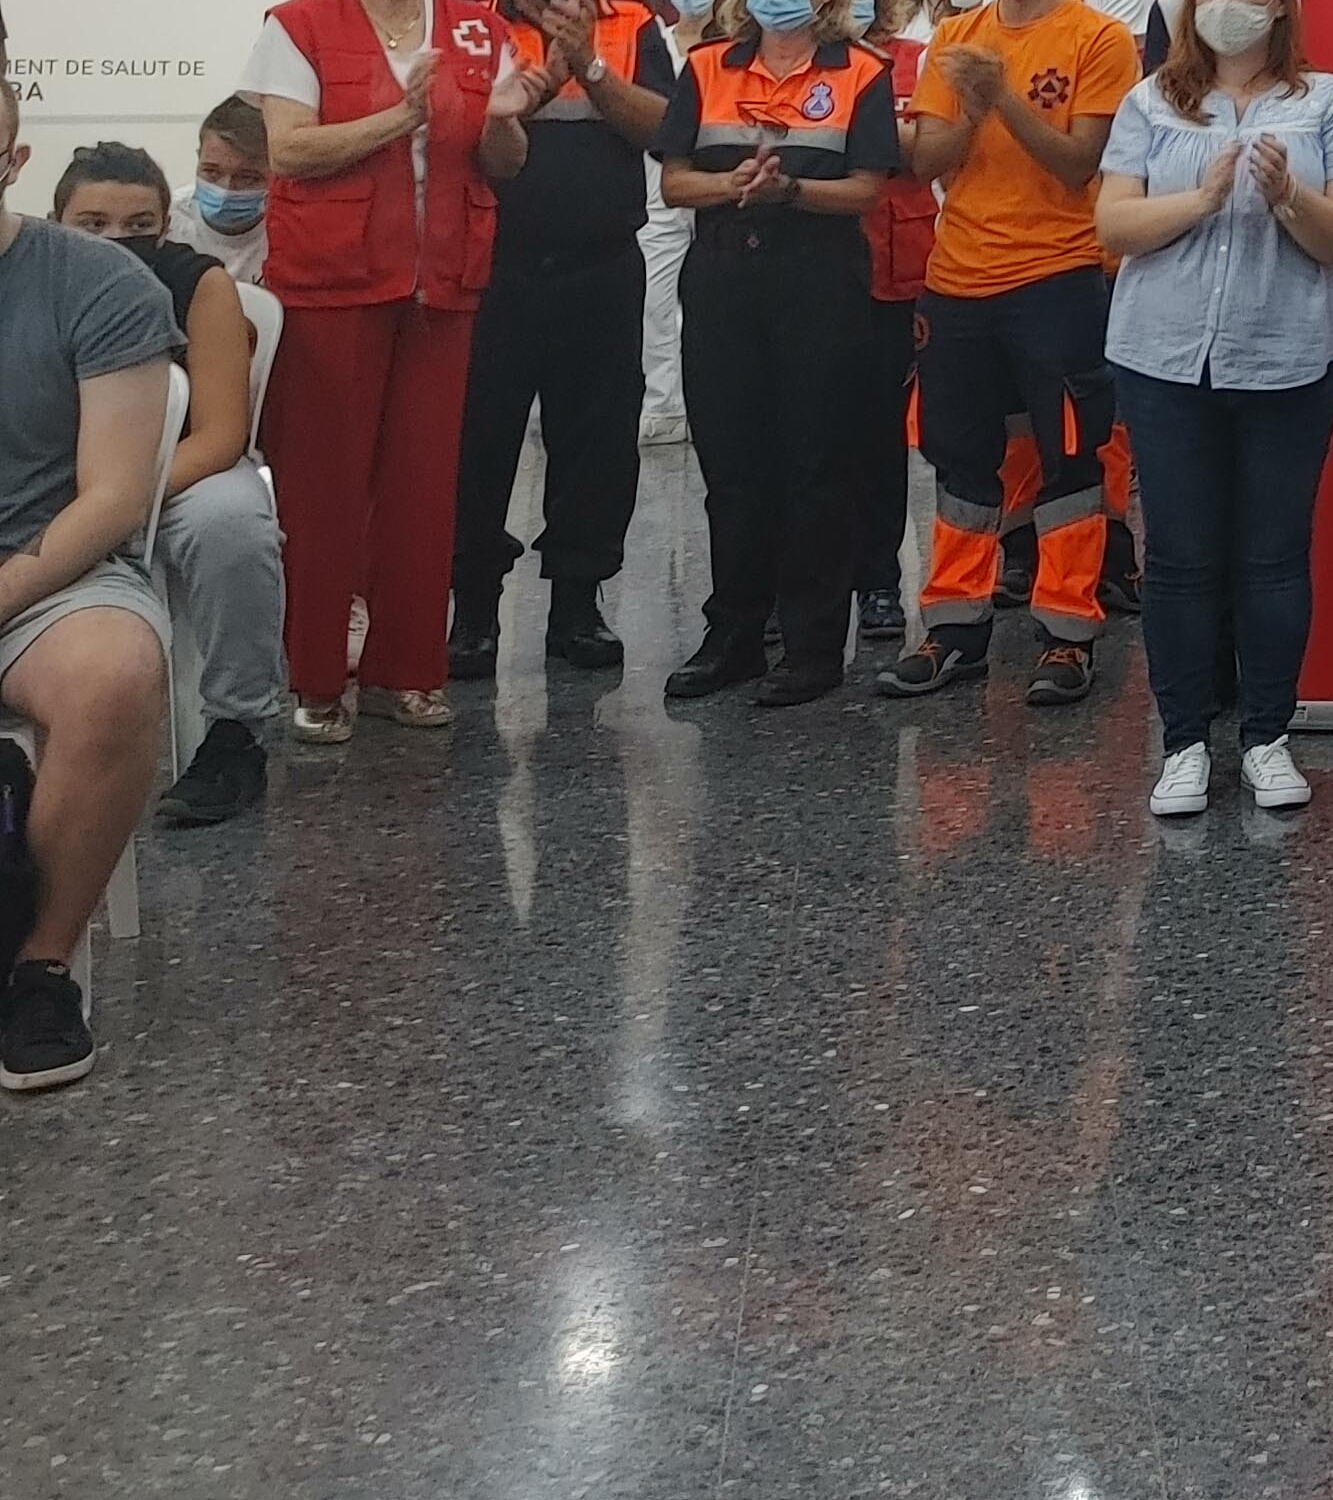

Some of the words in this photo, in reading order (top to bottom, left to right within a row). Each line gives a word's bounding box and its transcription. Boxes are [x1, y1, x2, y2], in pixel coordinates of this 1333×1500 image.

[65, 59, 94, 76] DE
[100, 59, 171, 77] SALUT
[177, 60, 206, 77] DE
